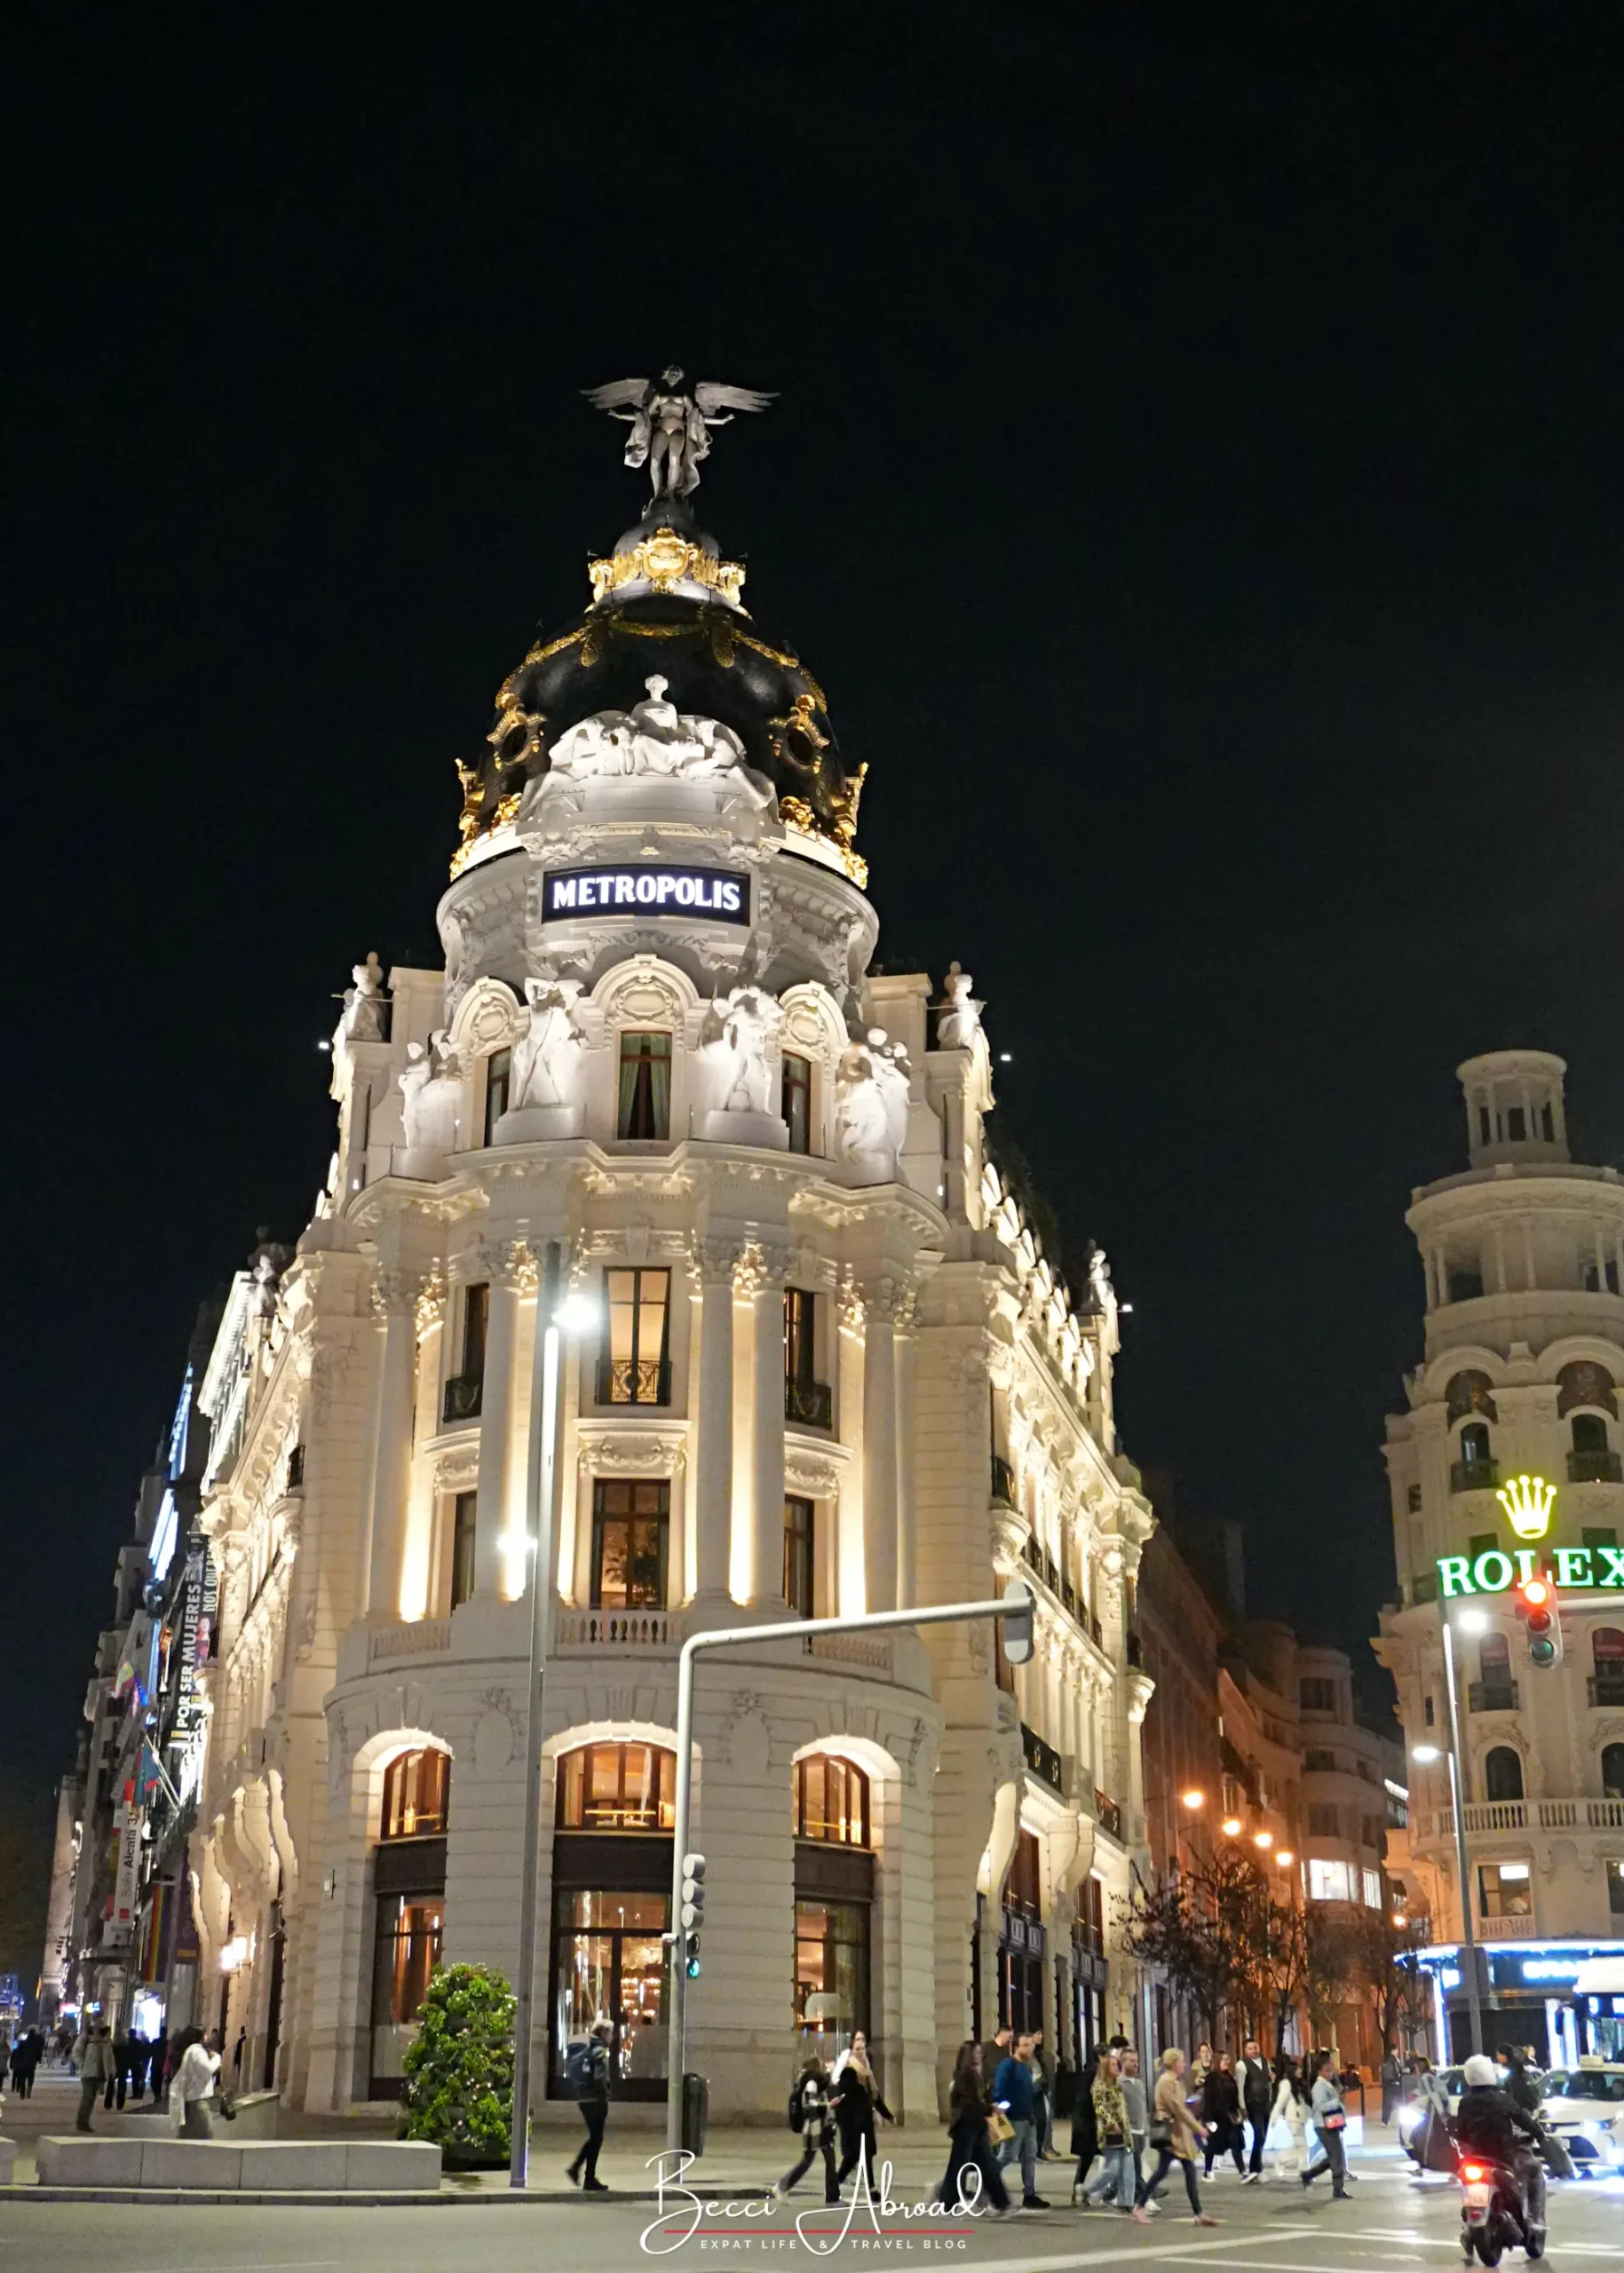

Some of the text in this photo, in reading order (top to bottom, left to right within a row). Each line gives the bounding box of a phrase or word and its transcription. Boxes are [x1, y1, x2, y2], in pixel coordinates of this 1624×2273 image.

[552, 875, 741, 911] METROPOLIS
[1437, 1548, 1624, 1596] ROLEX
[202, 1590, 217, 1612] NOS
[177, 1582, 202, 1728] POR SER MUJERES
[123, 1829, 137, 1869] Alcalá
